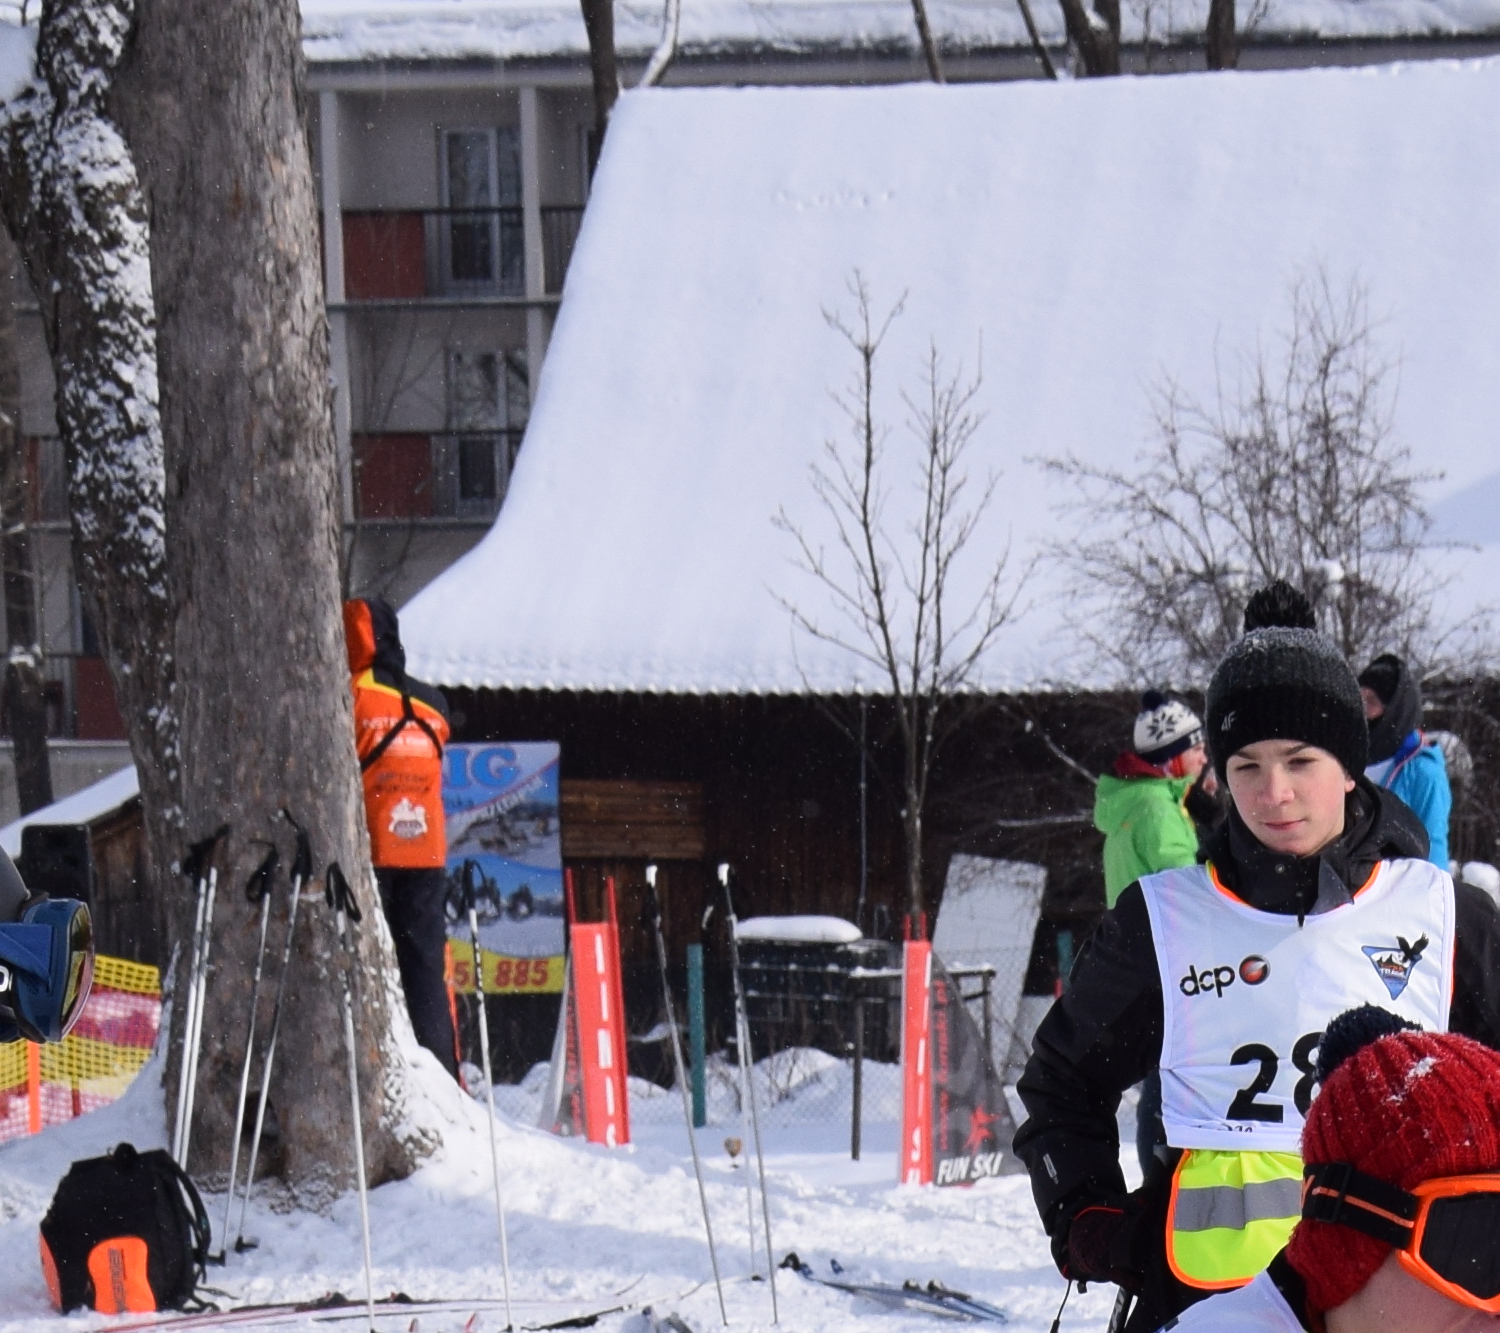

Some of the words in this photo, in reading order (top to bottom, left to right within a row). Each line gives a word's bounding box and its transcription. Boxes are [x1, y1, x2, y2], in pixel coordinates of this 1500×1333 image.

[454, 960, 476, 986] 5
[495, 959, 548, 988] 885
[1180, 965, 1235, 998] dcp
[936, 1157, 970, 1186] FUN
[971, 1152, 1004, 1179] SKI
